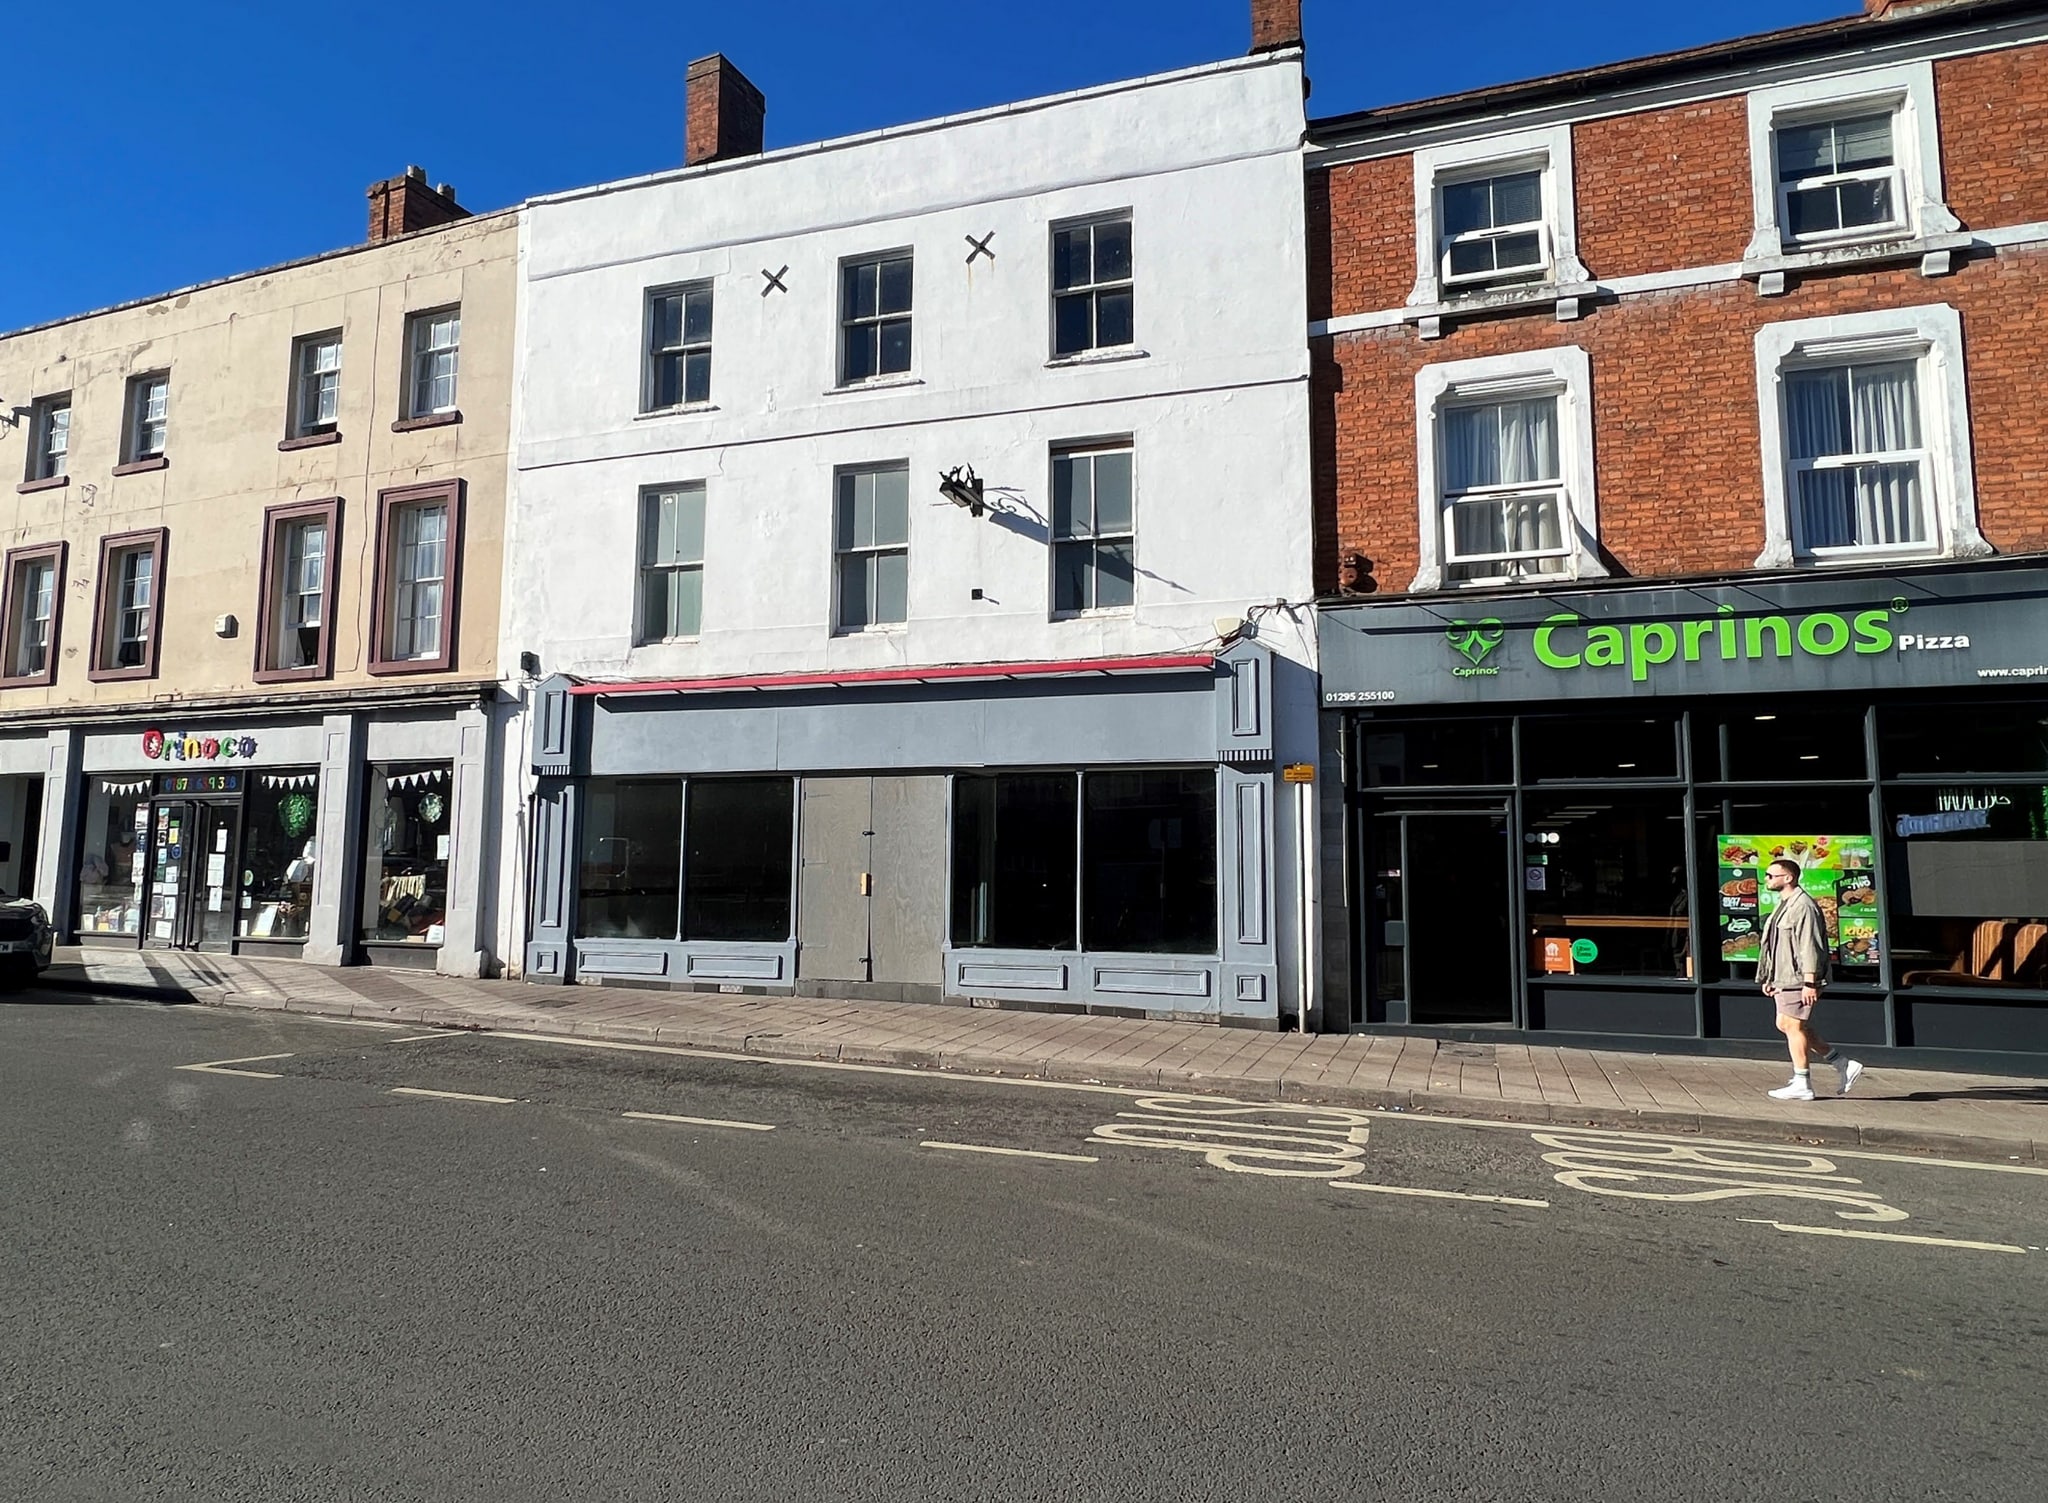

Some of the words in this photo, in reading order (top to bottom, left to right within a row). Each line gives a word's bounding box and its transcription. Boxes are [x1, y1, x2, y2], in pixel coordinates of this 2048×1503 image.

[1533, 604, 1893, 681] Caprinos
[1899, 634, 1970, 650] Pizza
[1453, 666, 1497, 676] Caprinos
[1326, 692, 1356, 701] 01295
[1358, 691, 1395, 700] 255100
[143, 728, 258, 761] Orinoco
[1084, 1098, 1370, 1178] STOP
[1531, 1132, 1909, 1222] BUS
